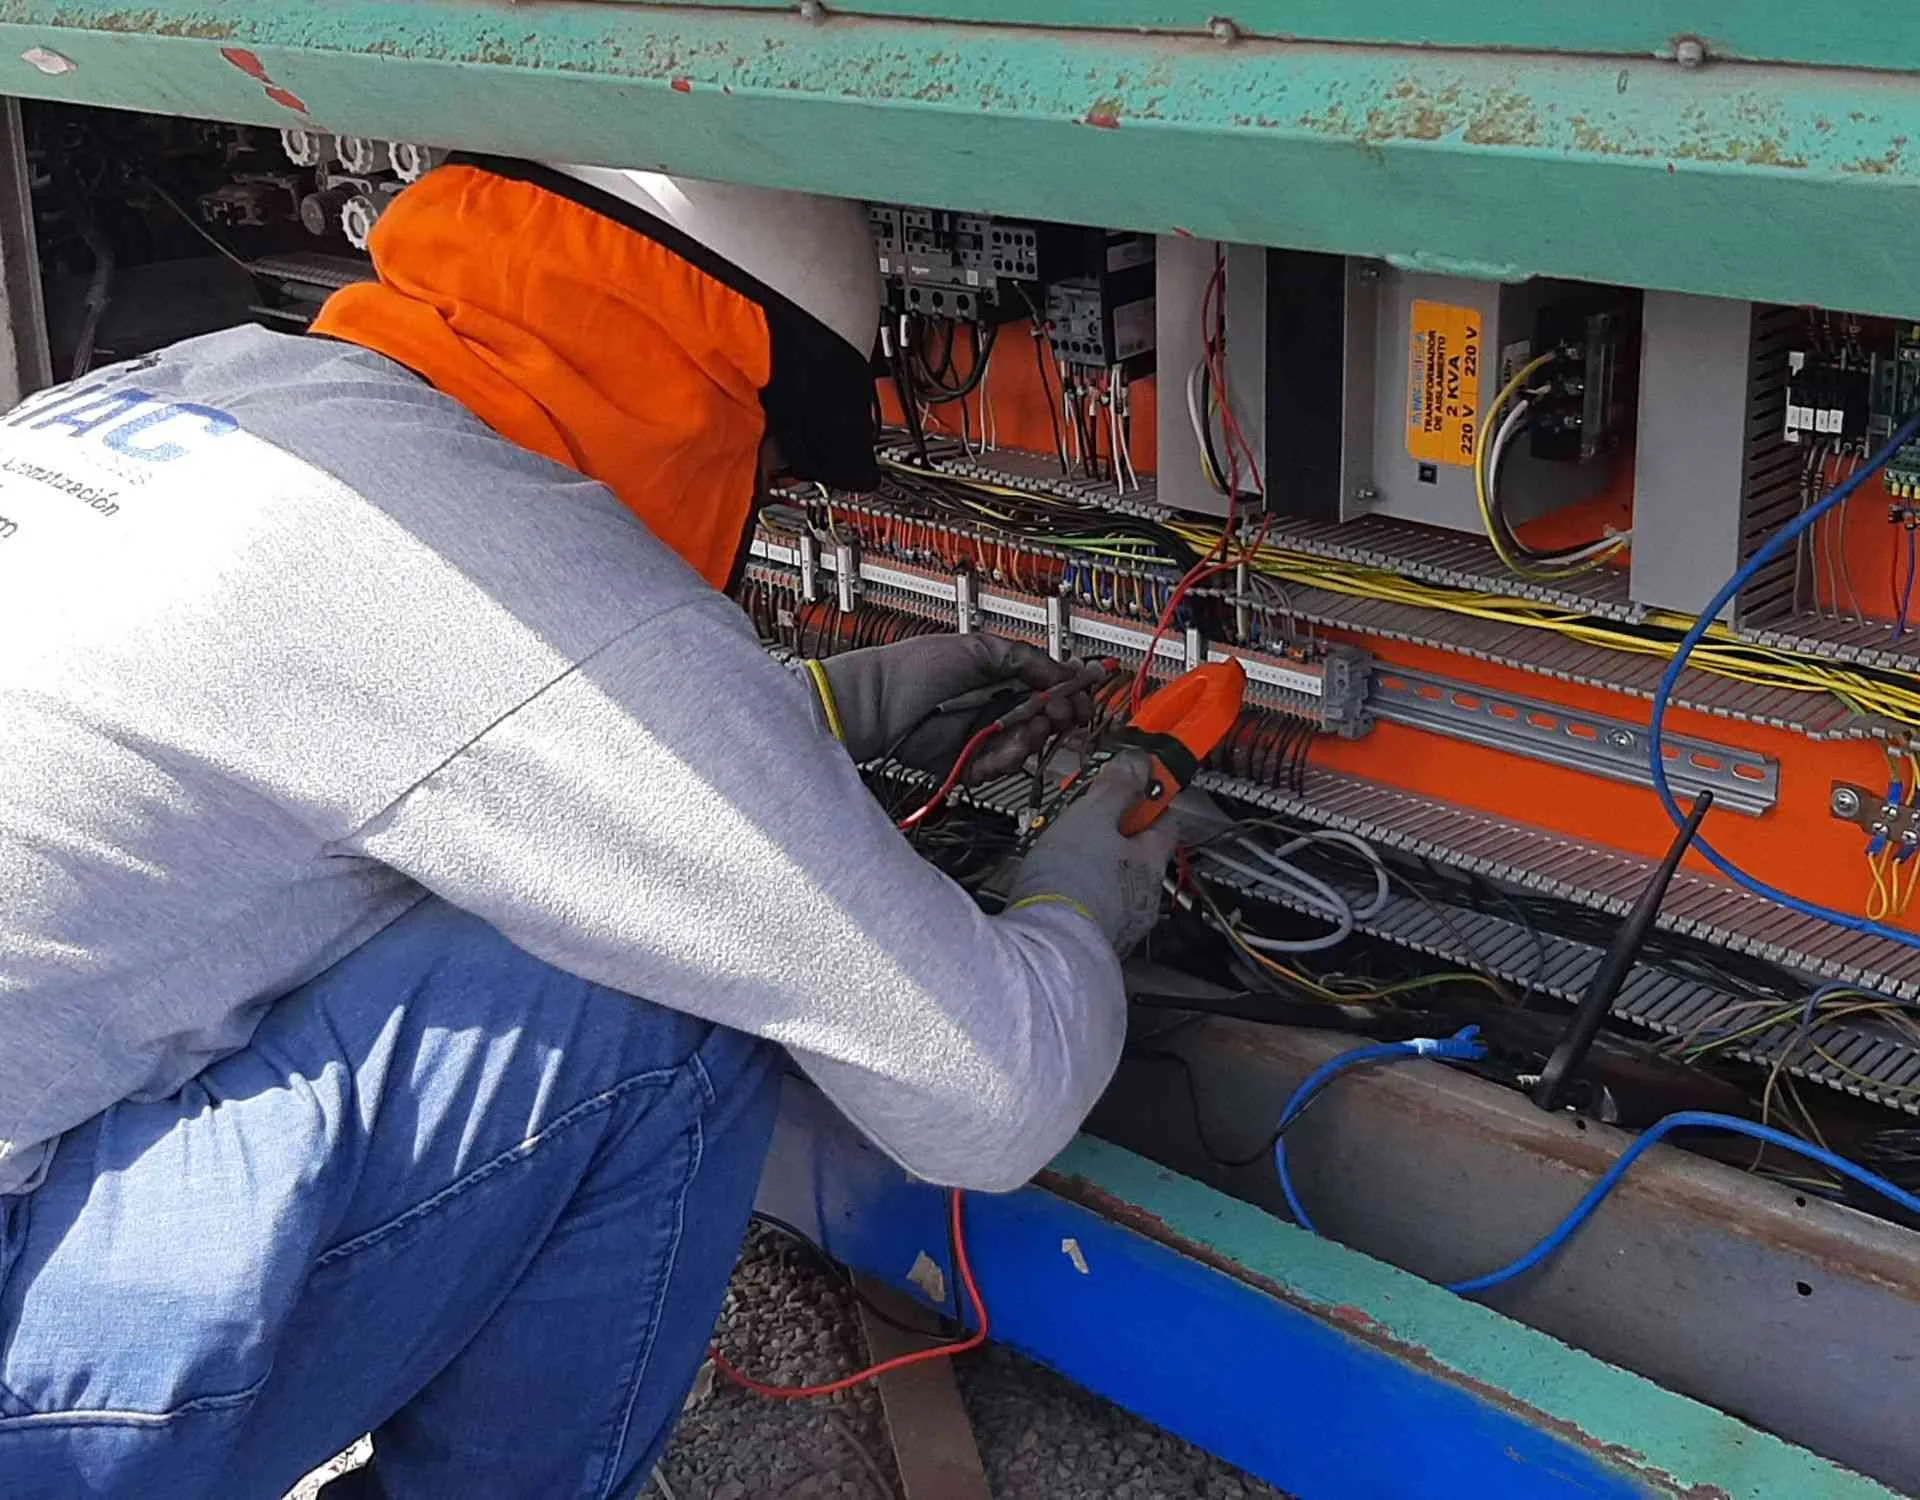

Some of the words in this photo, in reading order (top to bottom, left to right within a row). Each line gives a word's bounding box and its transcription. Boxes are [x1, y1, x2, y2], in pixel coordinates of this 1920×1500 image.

[1465, 326, 1477, 340] V
[1435, 335, 1446, 413] AISLAMIENTO
[1447, 355, 1460, 399] KVA
[1464, 345, 1477, 377] 220
[1424, 330, 1437, 433] TRANSFORMADOR
[1433, 415, 1443, 432] DE
[1446, 405, 1458, 417] 2
[1462, 404, 1474, 418] V
[1461, 423, 1473, 455] 220
